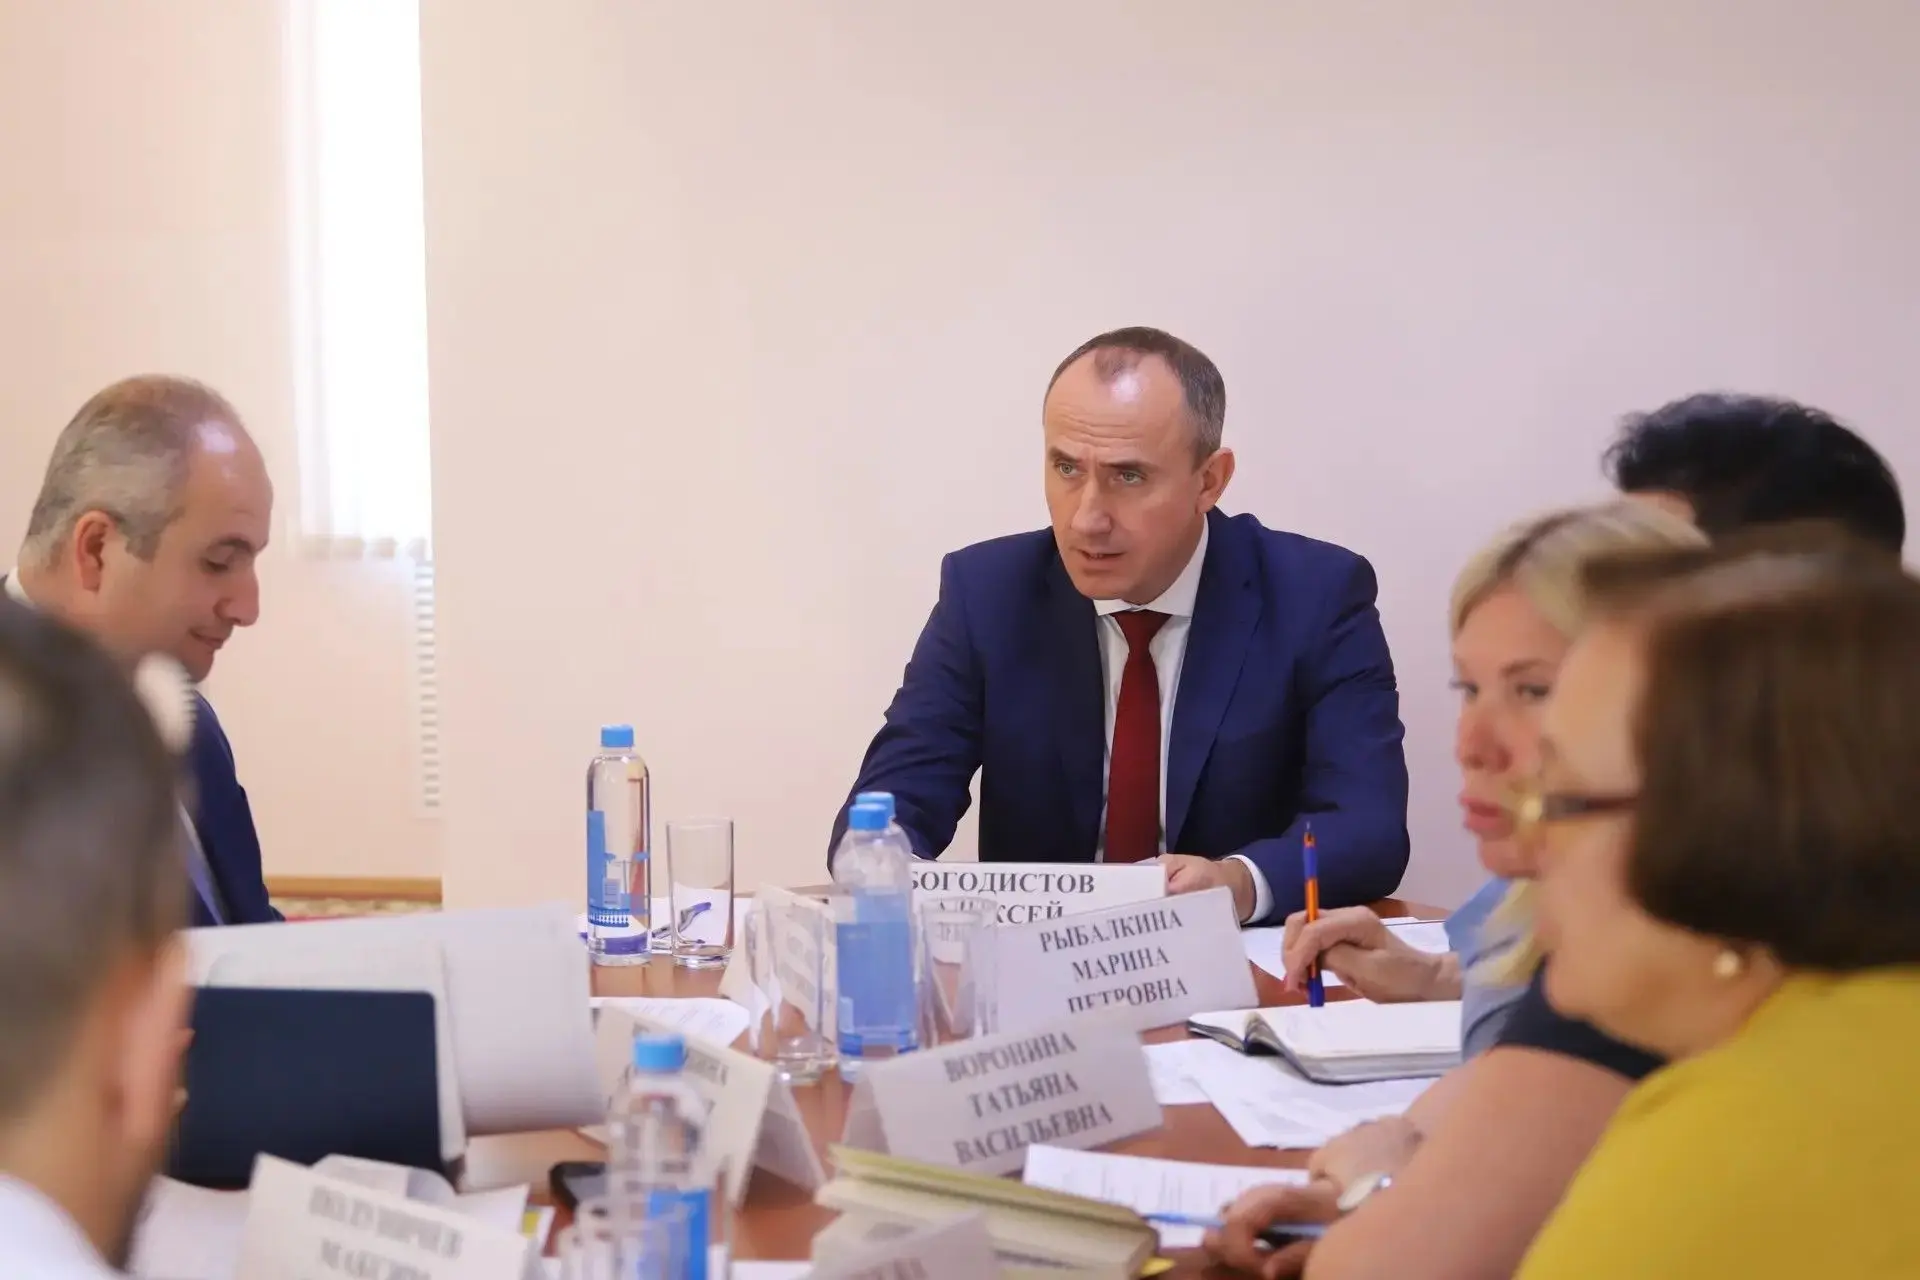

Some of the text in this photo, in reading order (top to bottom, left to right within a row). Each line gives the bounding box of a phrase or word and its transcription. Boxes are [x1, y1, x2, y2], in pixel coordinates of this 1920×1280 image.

[937, 899, 1063, 924] КСЕЙ
[1039, 907, 1183, 953] РЫБАЛКИНА
[1071, 946, 1170, 983] МАРИНА
[1066, 976, 1188, 1014] ПЕТРОВНА
[943, 1031, 1077, 1083] ВОРОНИНА
[968, 1070, 1079, 1119] ТАТЬЯНА
[953, 1101, 1114, 1165] ВАСИЛЬЕВНА
